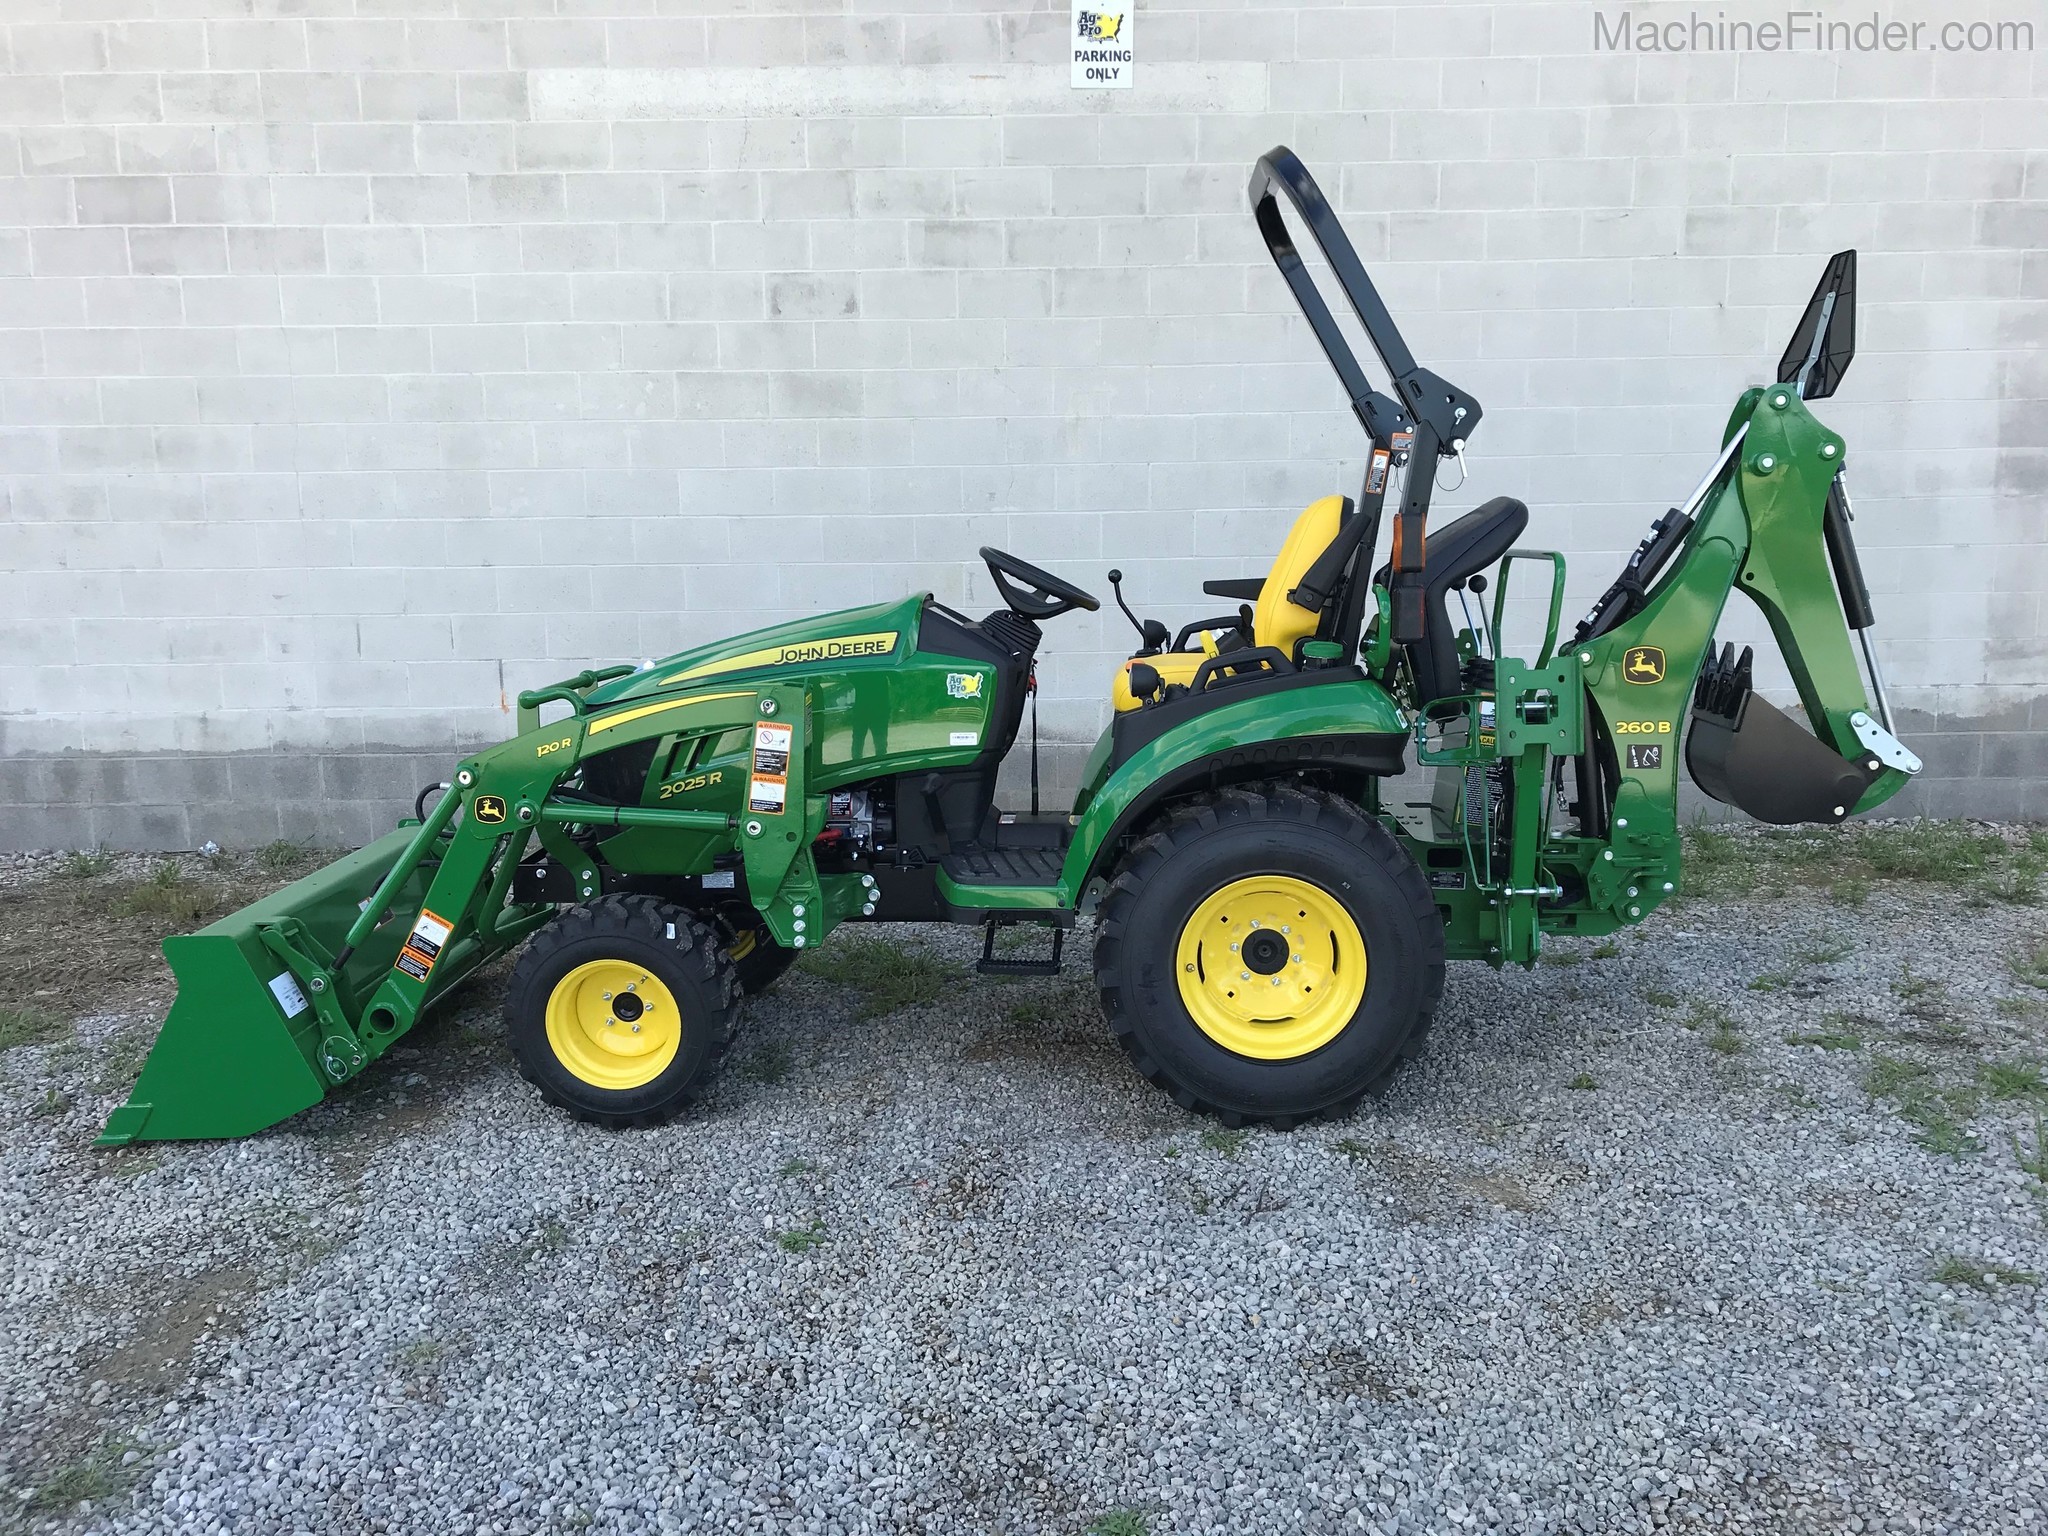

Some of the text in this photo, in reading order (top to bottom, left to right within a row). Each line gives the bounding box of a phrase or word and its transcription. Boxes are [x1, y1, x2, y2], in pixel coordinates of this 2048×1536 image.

[1079, 24, 1102, 36] Pro
[1074, 50, 1132, 62] PARKING
[1085, 68, 1120, 80] ONLY
[774, 640, 887, 664] JOHN DEERE
[950, 684, 967, 693] Pro
[764, 723, 791, 731] WARNING
[1616, 721, 1672, 734] 260 B
[536, 737, 573, 758] 120 R
[659, 771, 723, 800] 2025 R
